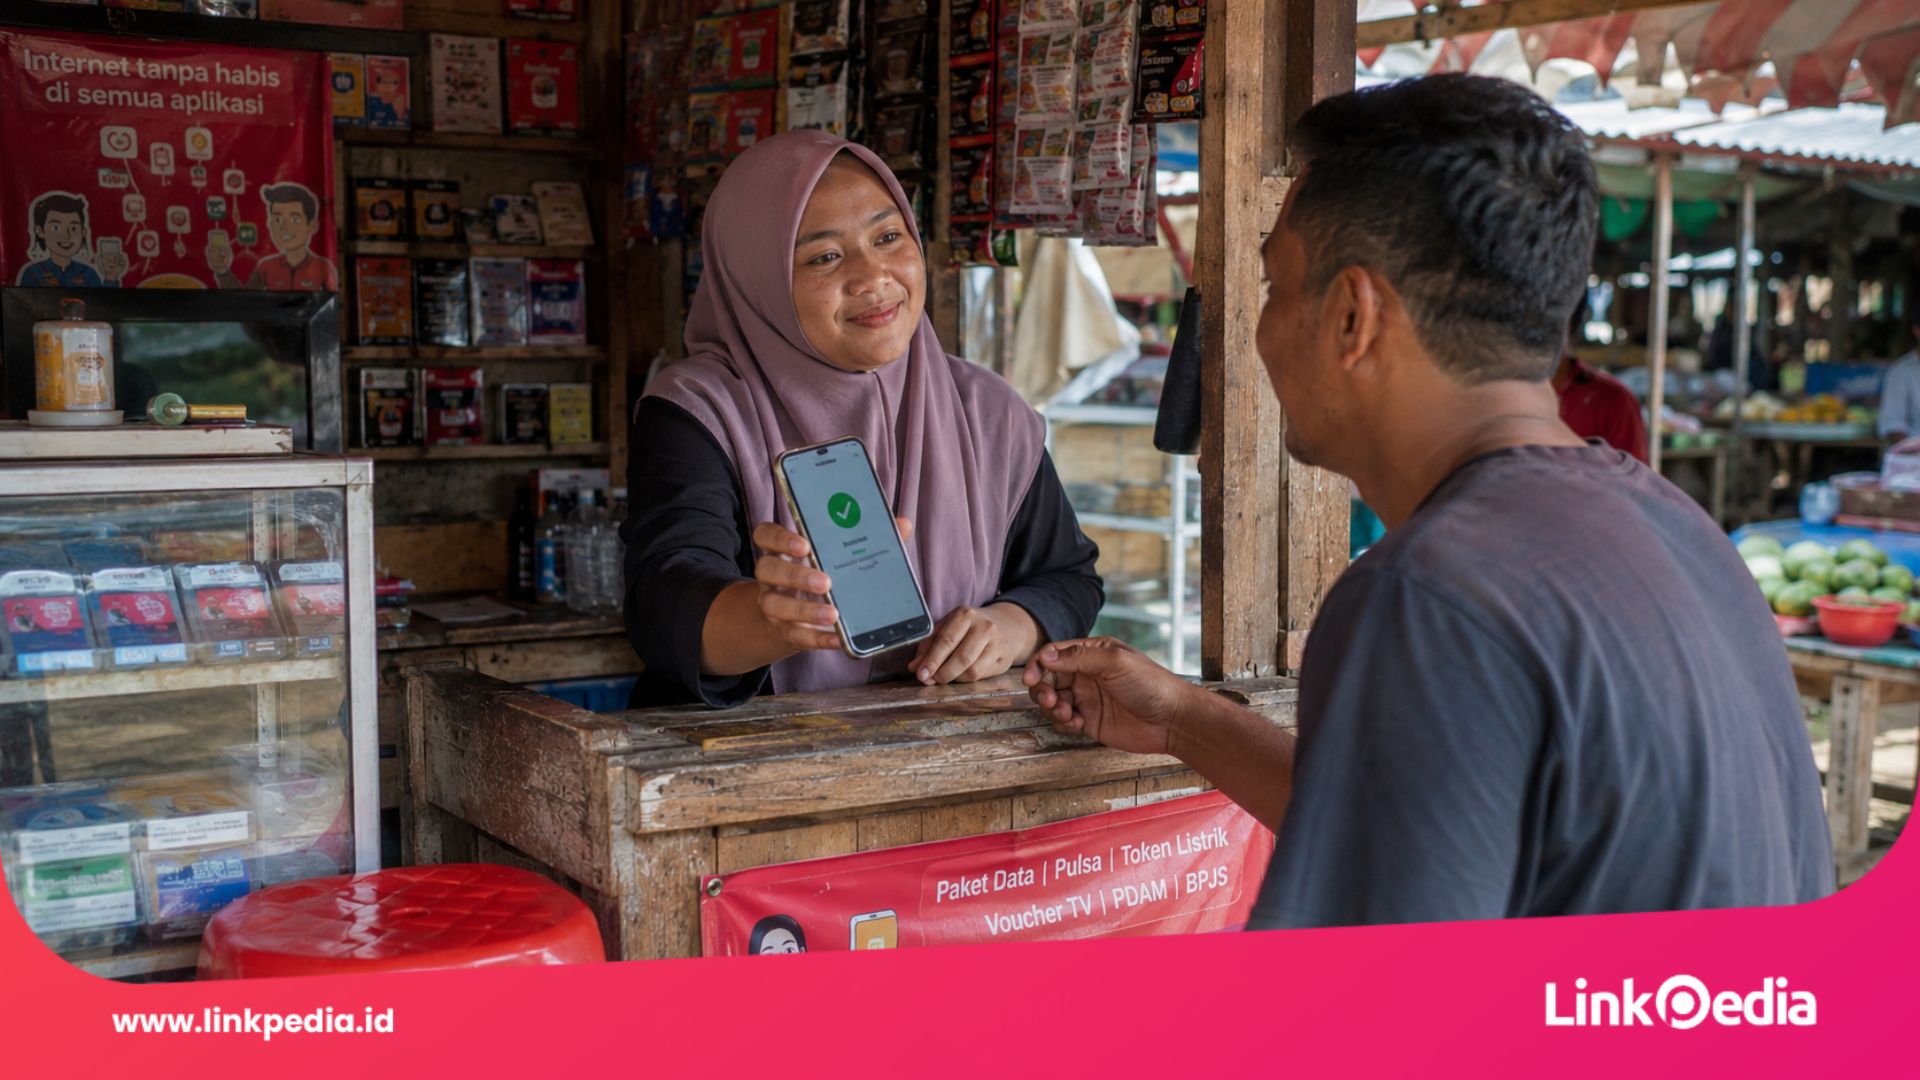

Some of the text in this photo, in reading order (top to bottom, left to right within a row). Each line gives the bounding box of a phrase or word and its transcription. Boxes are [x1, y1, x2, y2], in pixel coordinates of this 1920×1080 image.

[23, 48, 280, 88] Internet tanpa habis
[45, 80, 265, 116] di semua aplikasi
[936, 827, 1229, 903] Paket Data Pulsa Token Listrik
[984, 865, 1229, 936] Voucher TV PDAM BPJS
